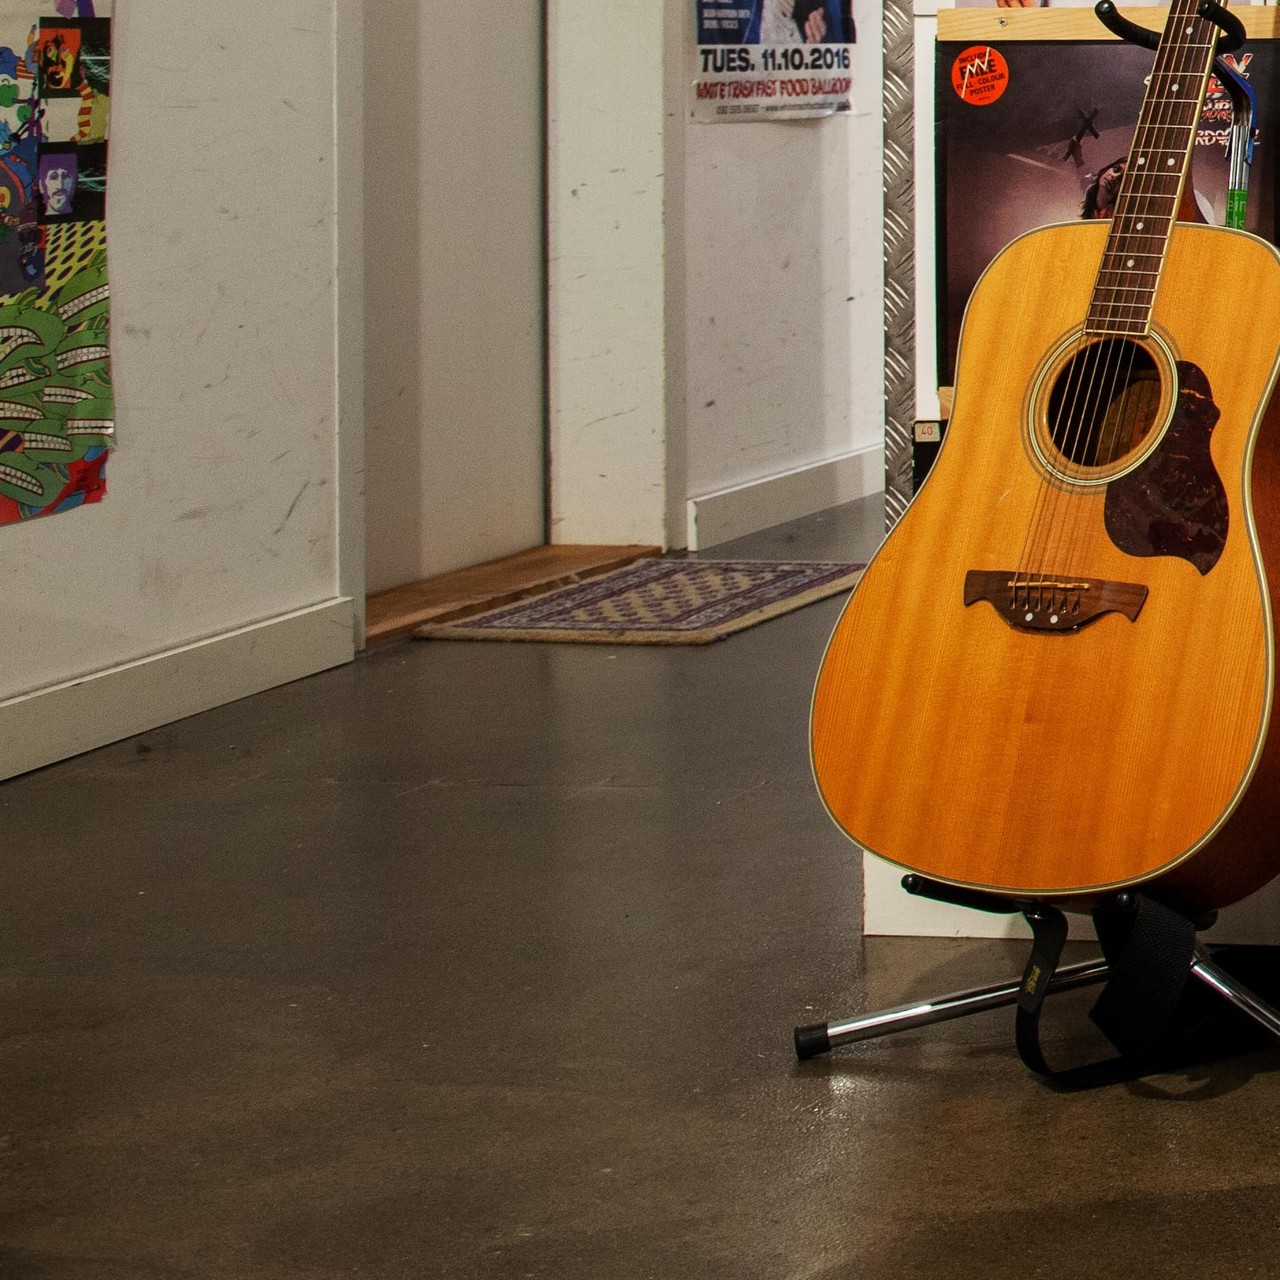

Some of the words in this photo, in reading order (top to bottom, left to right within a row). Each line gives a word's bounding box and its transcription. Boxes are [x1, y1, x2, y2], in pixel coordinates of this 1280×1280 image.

[701, 48, 755, 72] TUES.
[761, 47, 851, 72] 11.10.2016
[780, 79, 809, 97] FOOD
